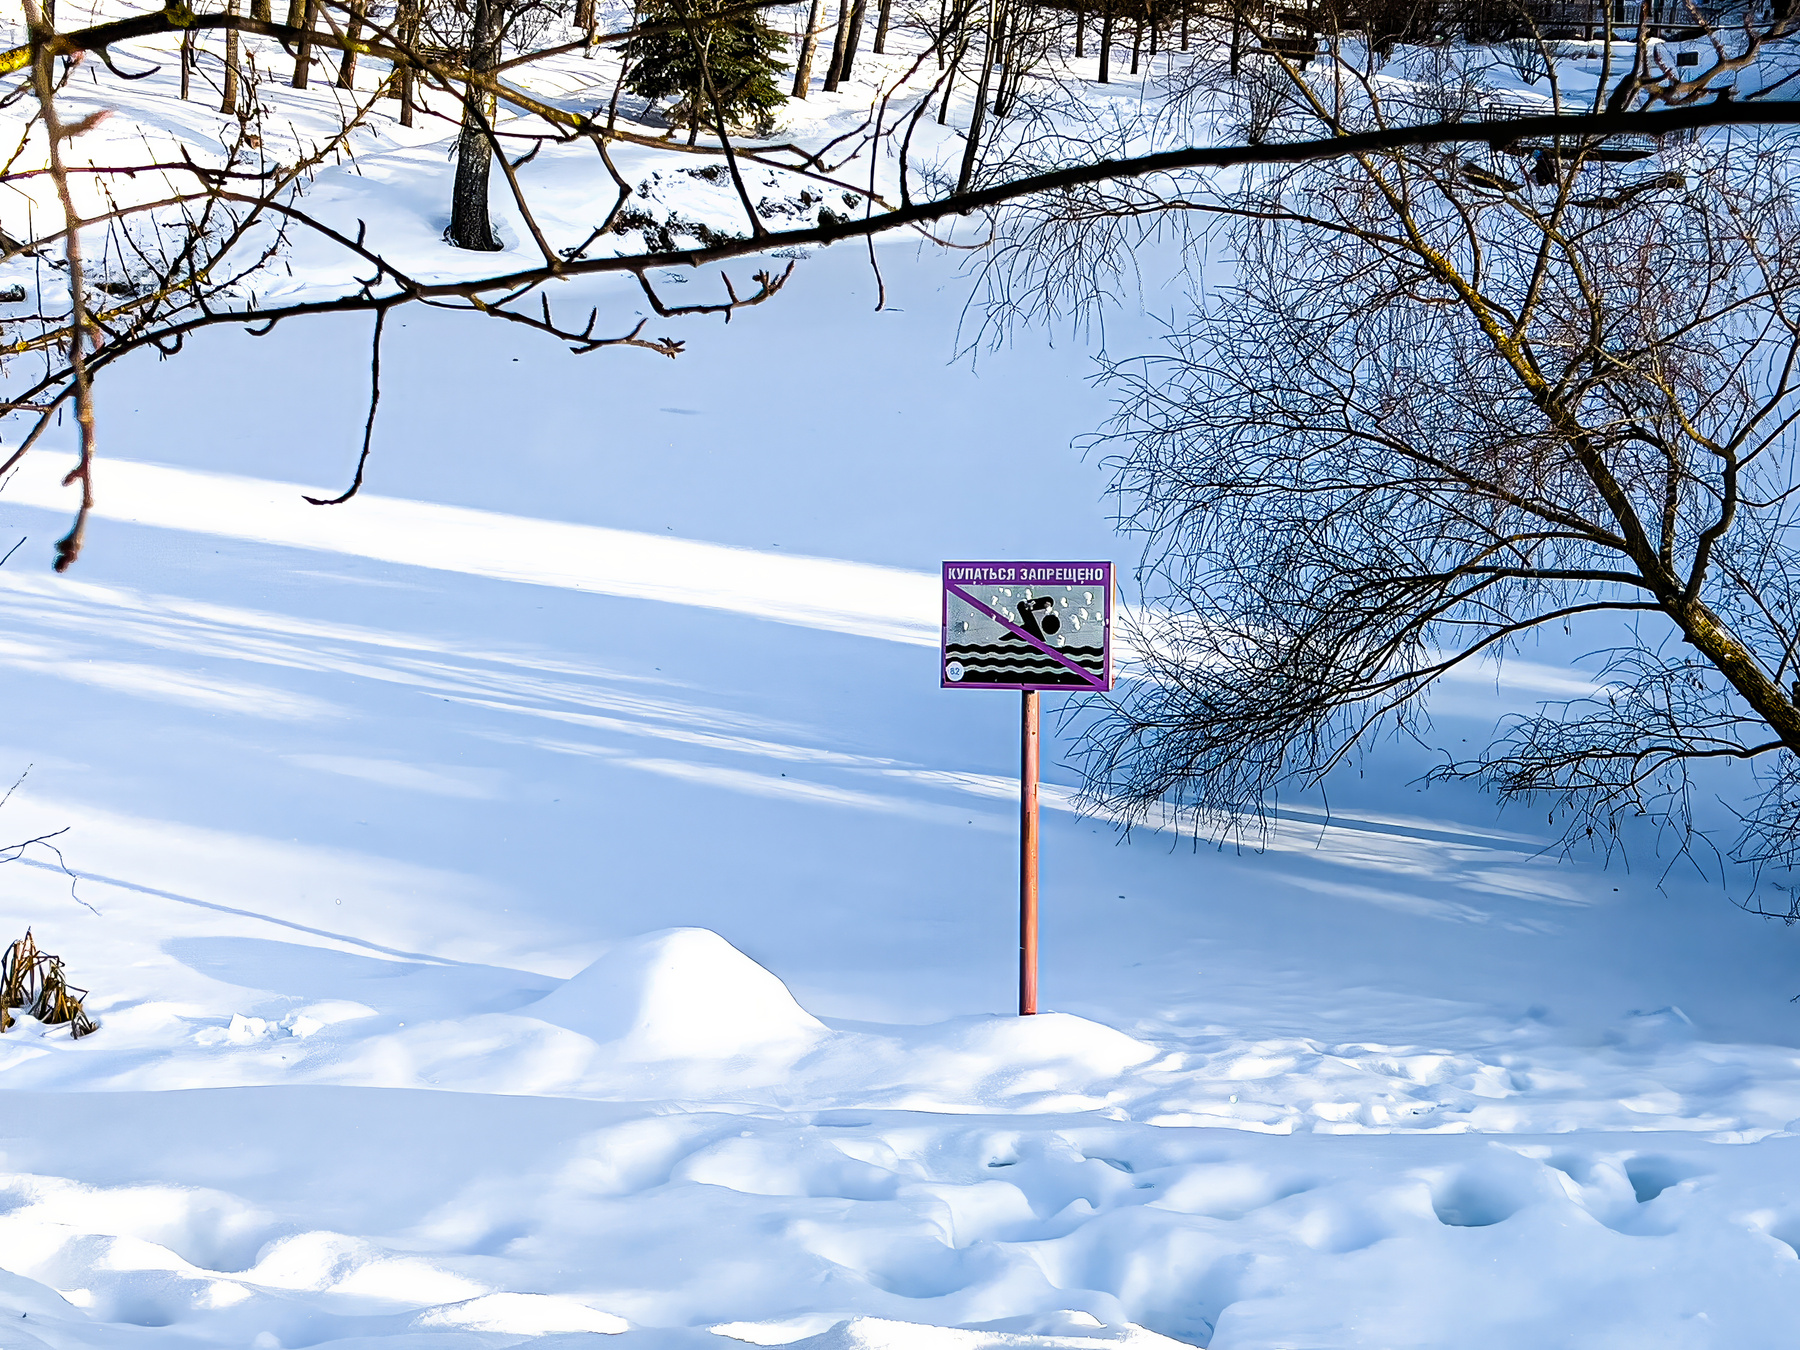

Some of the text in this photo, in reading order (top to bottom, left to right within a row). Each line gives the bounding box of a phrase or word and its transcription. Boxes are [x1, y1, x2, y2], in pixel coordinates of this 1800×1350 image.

[948, 568, 1104, 582] КУПАТЬСЯ ЗАПРЕЩЕНО
[950, 667, 960, 676] 82
